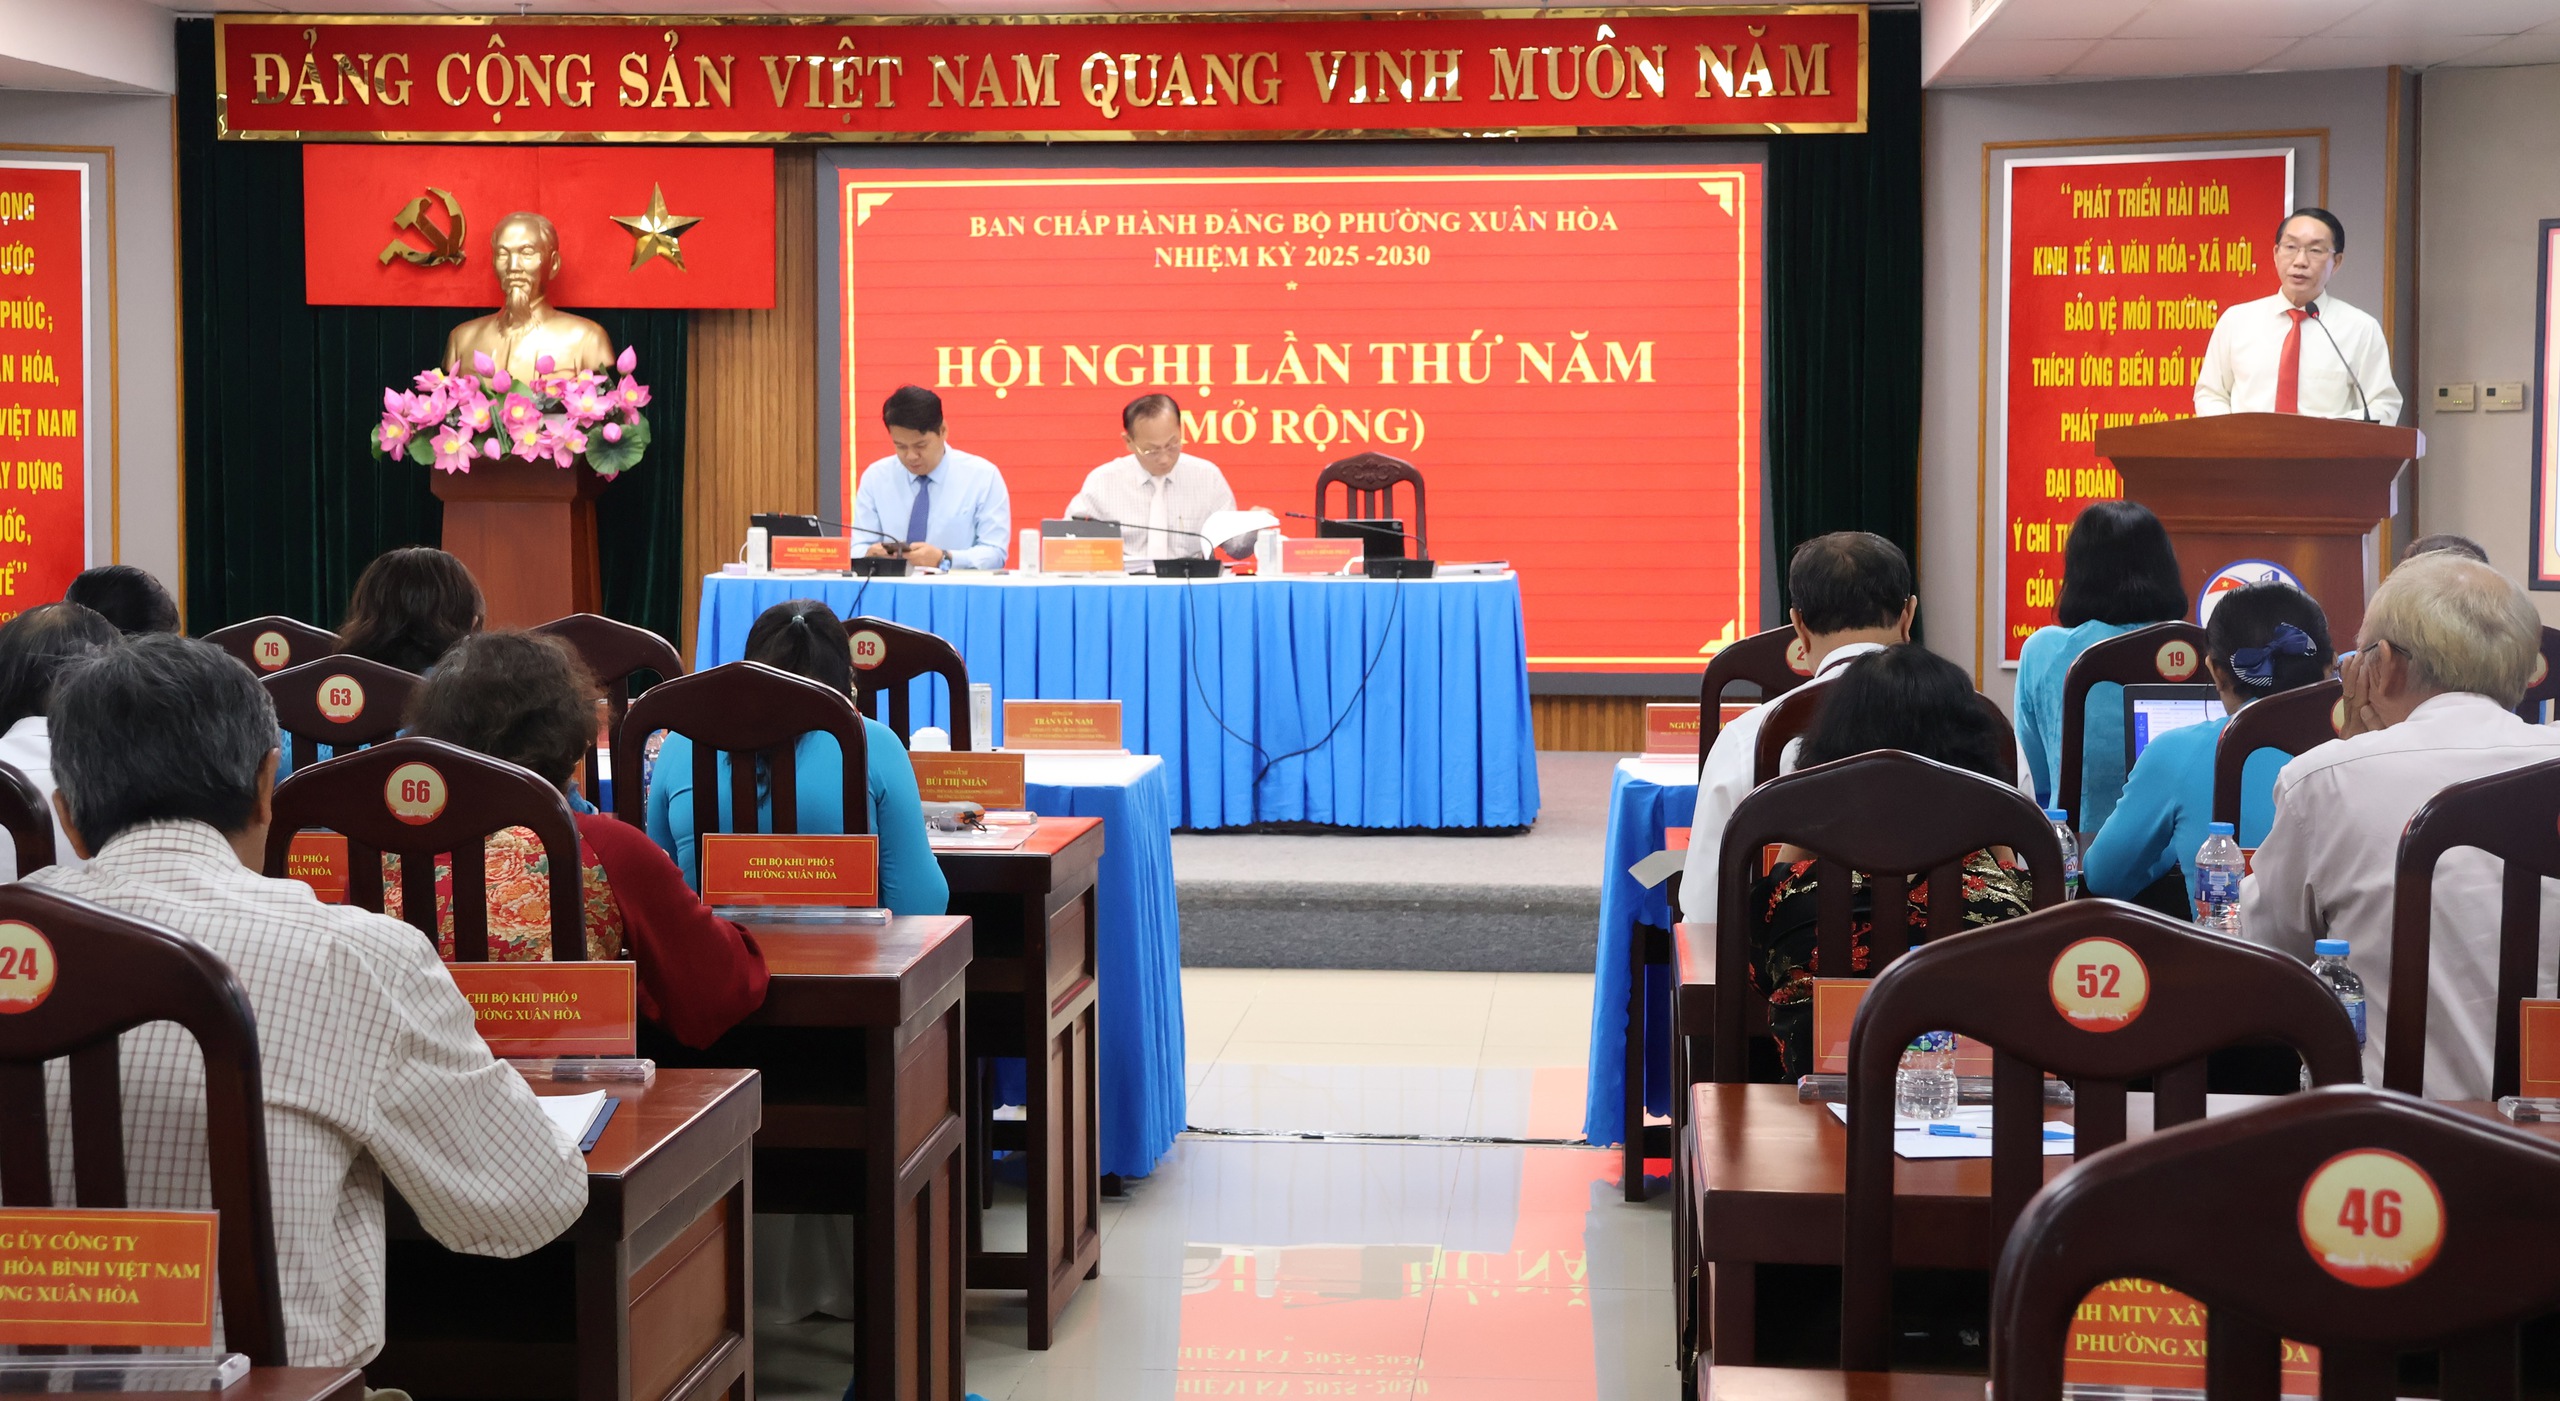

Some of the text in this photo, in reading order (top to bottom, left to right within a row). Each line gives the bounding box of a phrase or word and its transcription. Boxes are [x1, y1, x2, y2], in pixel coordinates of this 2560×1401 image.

[251, 24, 1831, 124] ĐẢNG CỘNG SẢN VIỆT NAM QUANG VINH MUÔN NĂM
[2117, 176, 2161, 218] TRIỂN
[2166, 182, 2193, 217] HÀI
[2198, 179, 2230, 215] HÒA
[969, 205, 1619, 239] BAN CHẤP HÀNH ĐẢNG BỘ PHƯỜNG XUÂN HÒA
[1154, 244, 1248, 273] NHIỆM
[1256, 241, 1296, 267] KỲ
[1304, 245, 1360, 267] 2025
[2032, 246, 2068, 276] KINH
[2074, 237, 2093, 275] TẾ
[2097, 239, 2115, 275] VÀ
[2120, 239, 2150, 274] VĂN
[2156, 238, 2188, 273] HÓA
[2198, 237, 2221, 273] XÃ
[2064, 292, 2095, 331] BẢO
[2099, 296, 2118, 335] VỆ
[2122, 296, 2151, 331] MÔI
[934, 329, 1657, 399] HỘI NGHỊ LẦN THỨ NĂM
[2032, 352, 2074, 387] THÍCH
[2080, 351, 2113, 387] ỨNG
[2119, 350, 2154, 387] BIẾN
[2158, 345, 2185, 387] ĐỔI
[37, 409, 77, 437] NAM
[1269, 403, 1425, 452] RỘNG)
[2060, 406, 2099, 442] PHÁT
[17, 458, 63, 494] DỰNG
[2045, 462, 2117, 503] ĐẠI ĐOÀN
[2013, 516, 2023, 552] Ý
[2026, 517, 2051, 553] CHÍ
[2025, 568, 2055, 608] CỦA
[264, 642, 279, 657] 76
[857, 641, 875, 656] 83
[2167, 651, 2185, 667] 19
[330, 688, 351, 706] 63
[402, 779, 430, 803] 66
[287, 854, 301, 863] HU
[324, 855, 330, 863] 4
[288, 865, 332, 876] UÂN HÒA
[744, 868, 837, 880] PHƯỜNG XUÂN HÒA
[749, 857, 767, 866] CHI
[769, 857, 783, 868] BỘ
[785, 857, 806, 866] KHU
[829, 858, 835, 866] 5
[0, 946, 39, 981] 24
[2077, 964, 2120, 998] 52
[466, 993, 488, 1004] CHI
[491, 991, 509, 1005] BỘ
[512, 993, 540, 1004] KHU
[571, 993, 578, 1003] 9
[474, 1007, 582, 1021] ƯỜNG XUÂN HÒA
[2338, 1188, 2402, 1239] 46
[50, 1231, 108, 1251] CÔNG
[112, 1235, 139, 1252] TY
[4, 1256, 201, 1282] HÒA BÌNH VIỆT NAM
[0, 1283, 140, 1304] NG XUÂN HÒA
[2108, 1304, 2163, 1324] MTV
[2075, 1331, 2178, 1357] PHƯỜNG
[2281, 1338, 2310, 1363] ÒA
